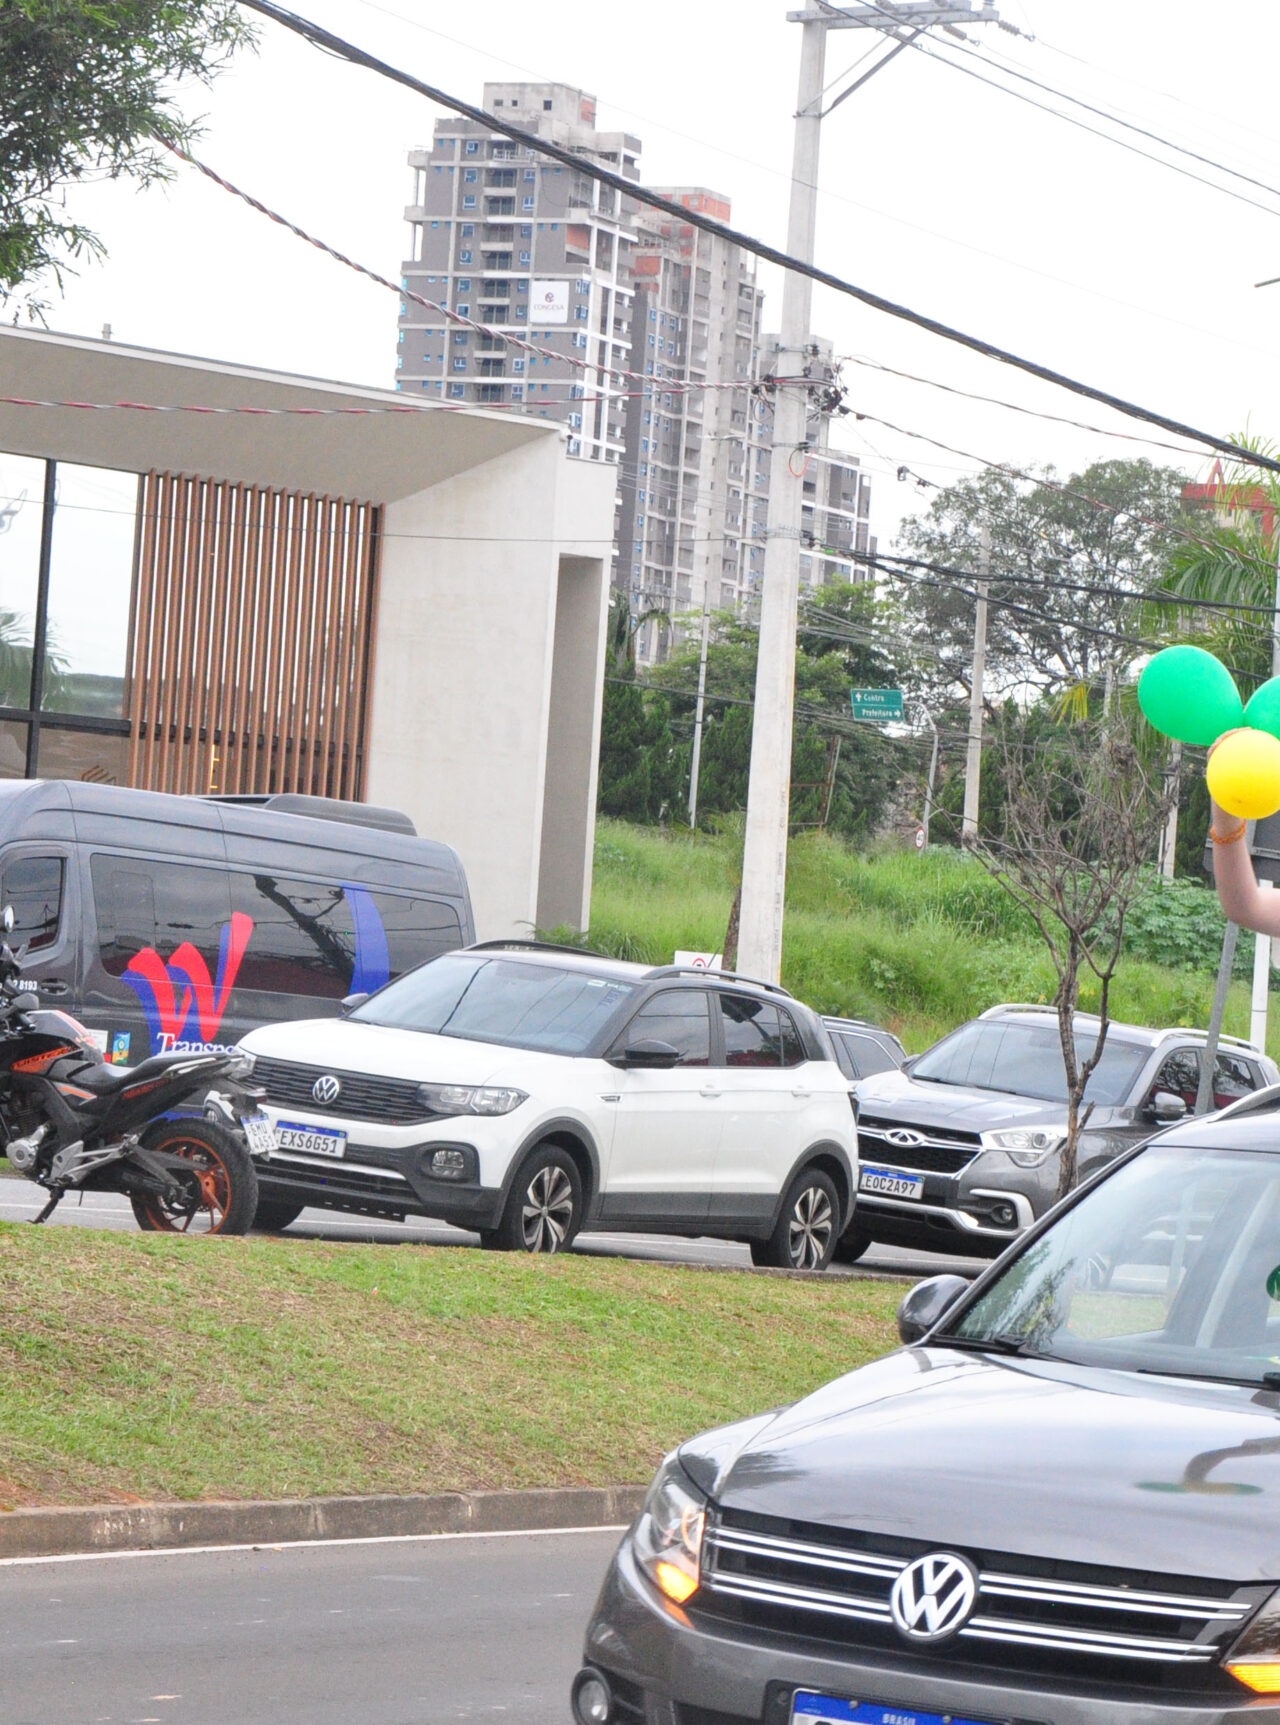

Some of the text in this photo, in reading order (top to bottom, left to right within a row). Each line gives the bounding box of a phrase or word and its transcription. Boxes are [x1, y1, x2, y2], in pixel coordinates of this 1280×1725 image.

[863, 693, 885, 702] Centro
[862, 708, 893, 717] Prefeitura
[280, 1130, 338, 1154] EXS6G51
